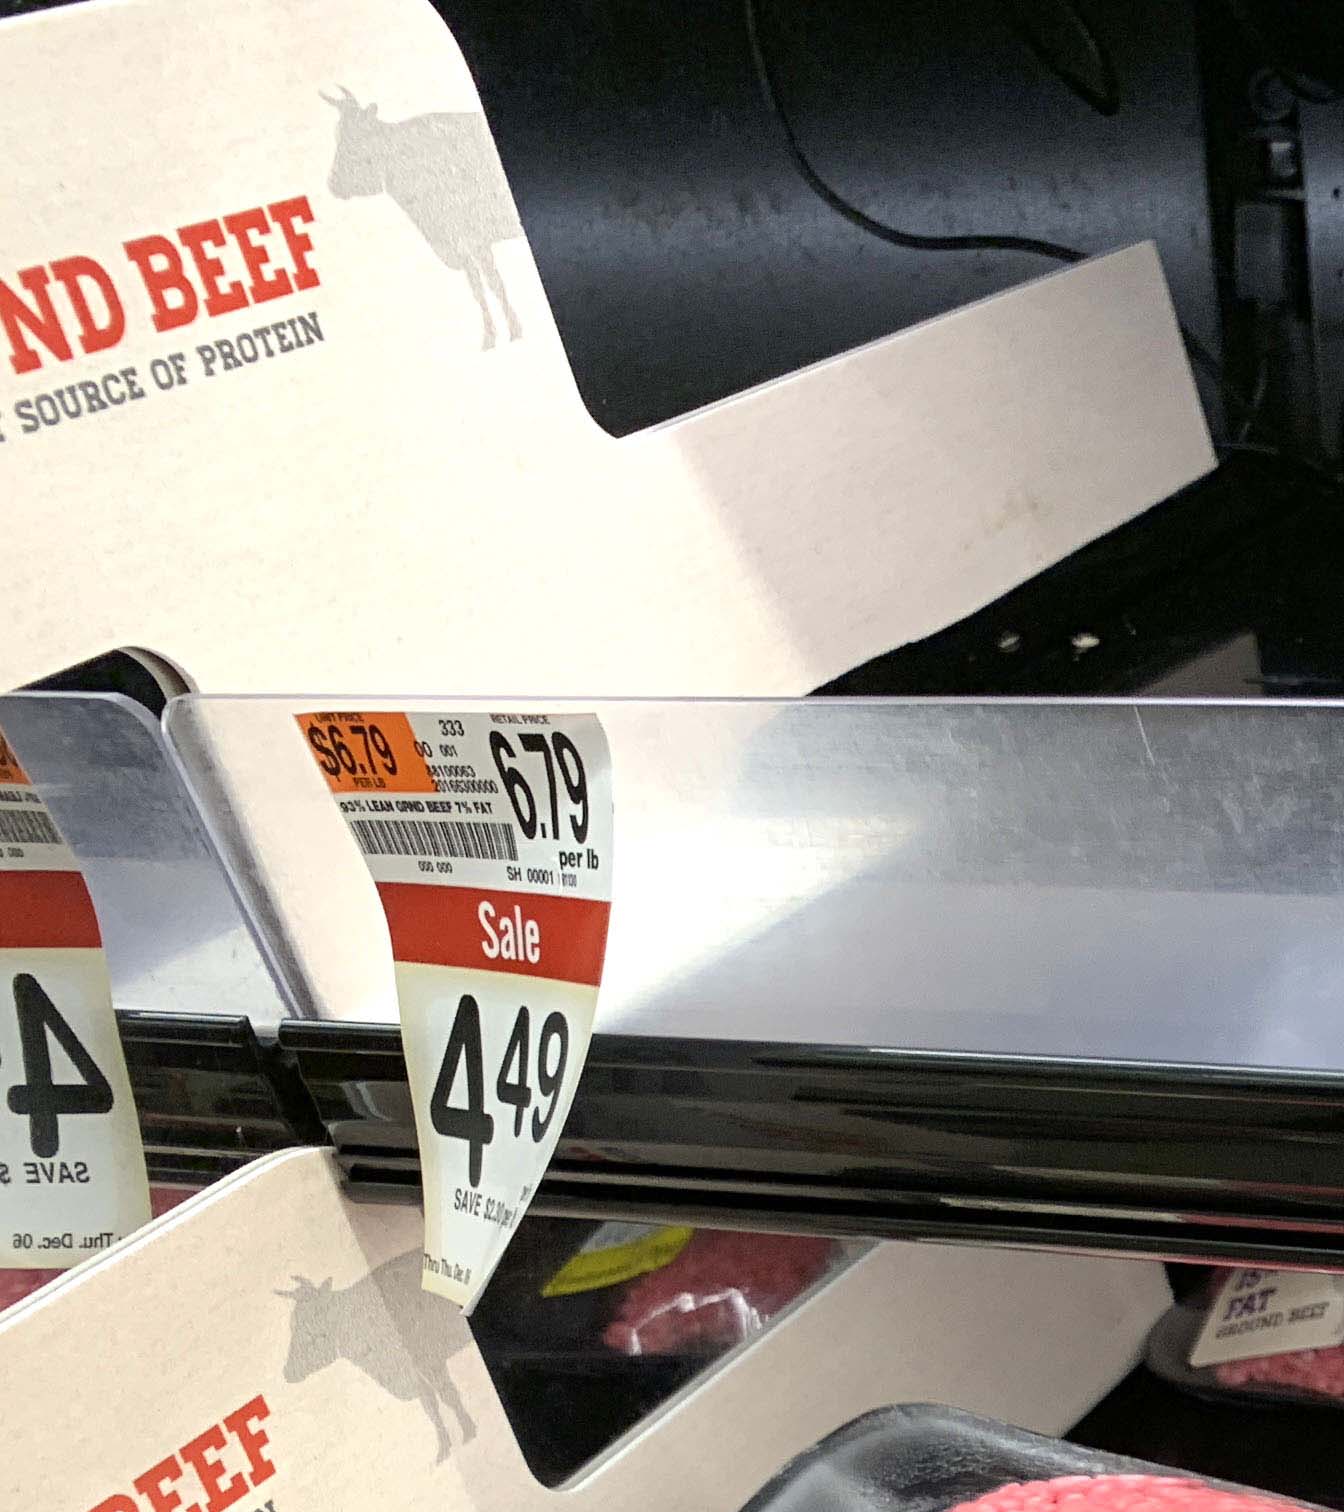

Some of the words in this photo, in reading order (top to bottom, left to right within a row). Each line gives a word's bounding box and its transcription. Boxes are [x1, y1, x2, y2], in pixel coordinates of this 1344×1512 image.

[121, 195, 320, 333] BEEF
[14, 366, 146, 433] SOURCE
[150, 352, 189, 391] OF
[195, 311, 325, 378] PROTEIN
[307, 721, 398, 783] $6.79
[439, 720, 465, 737] 333
[489, 730, 590, 844] 6.79
[558, 850, 583, 870] per
[586, 848, 599, 870] lb
[477, 899, 541, 965] Sale
[454, 1188, 482, 1216] SAVE
